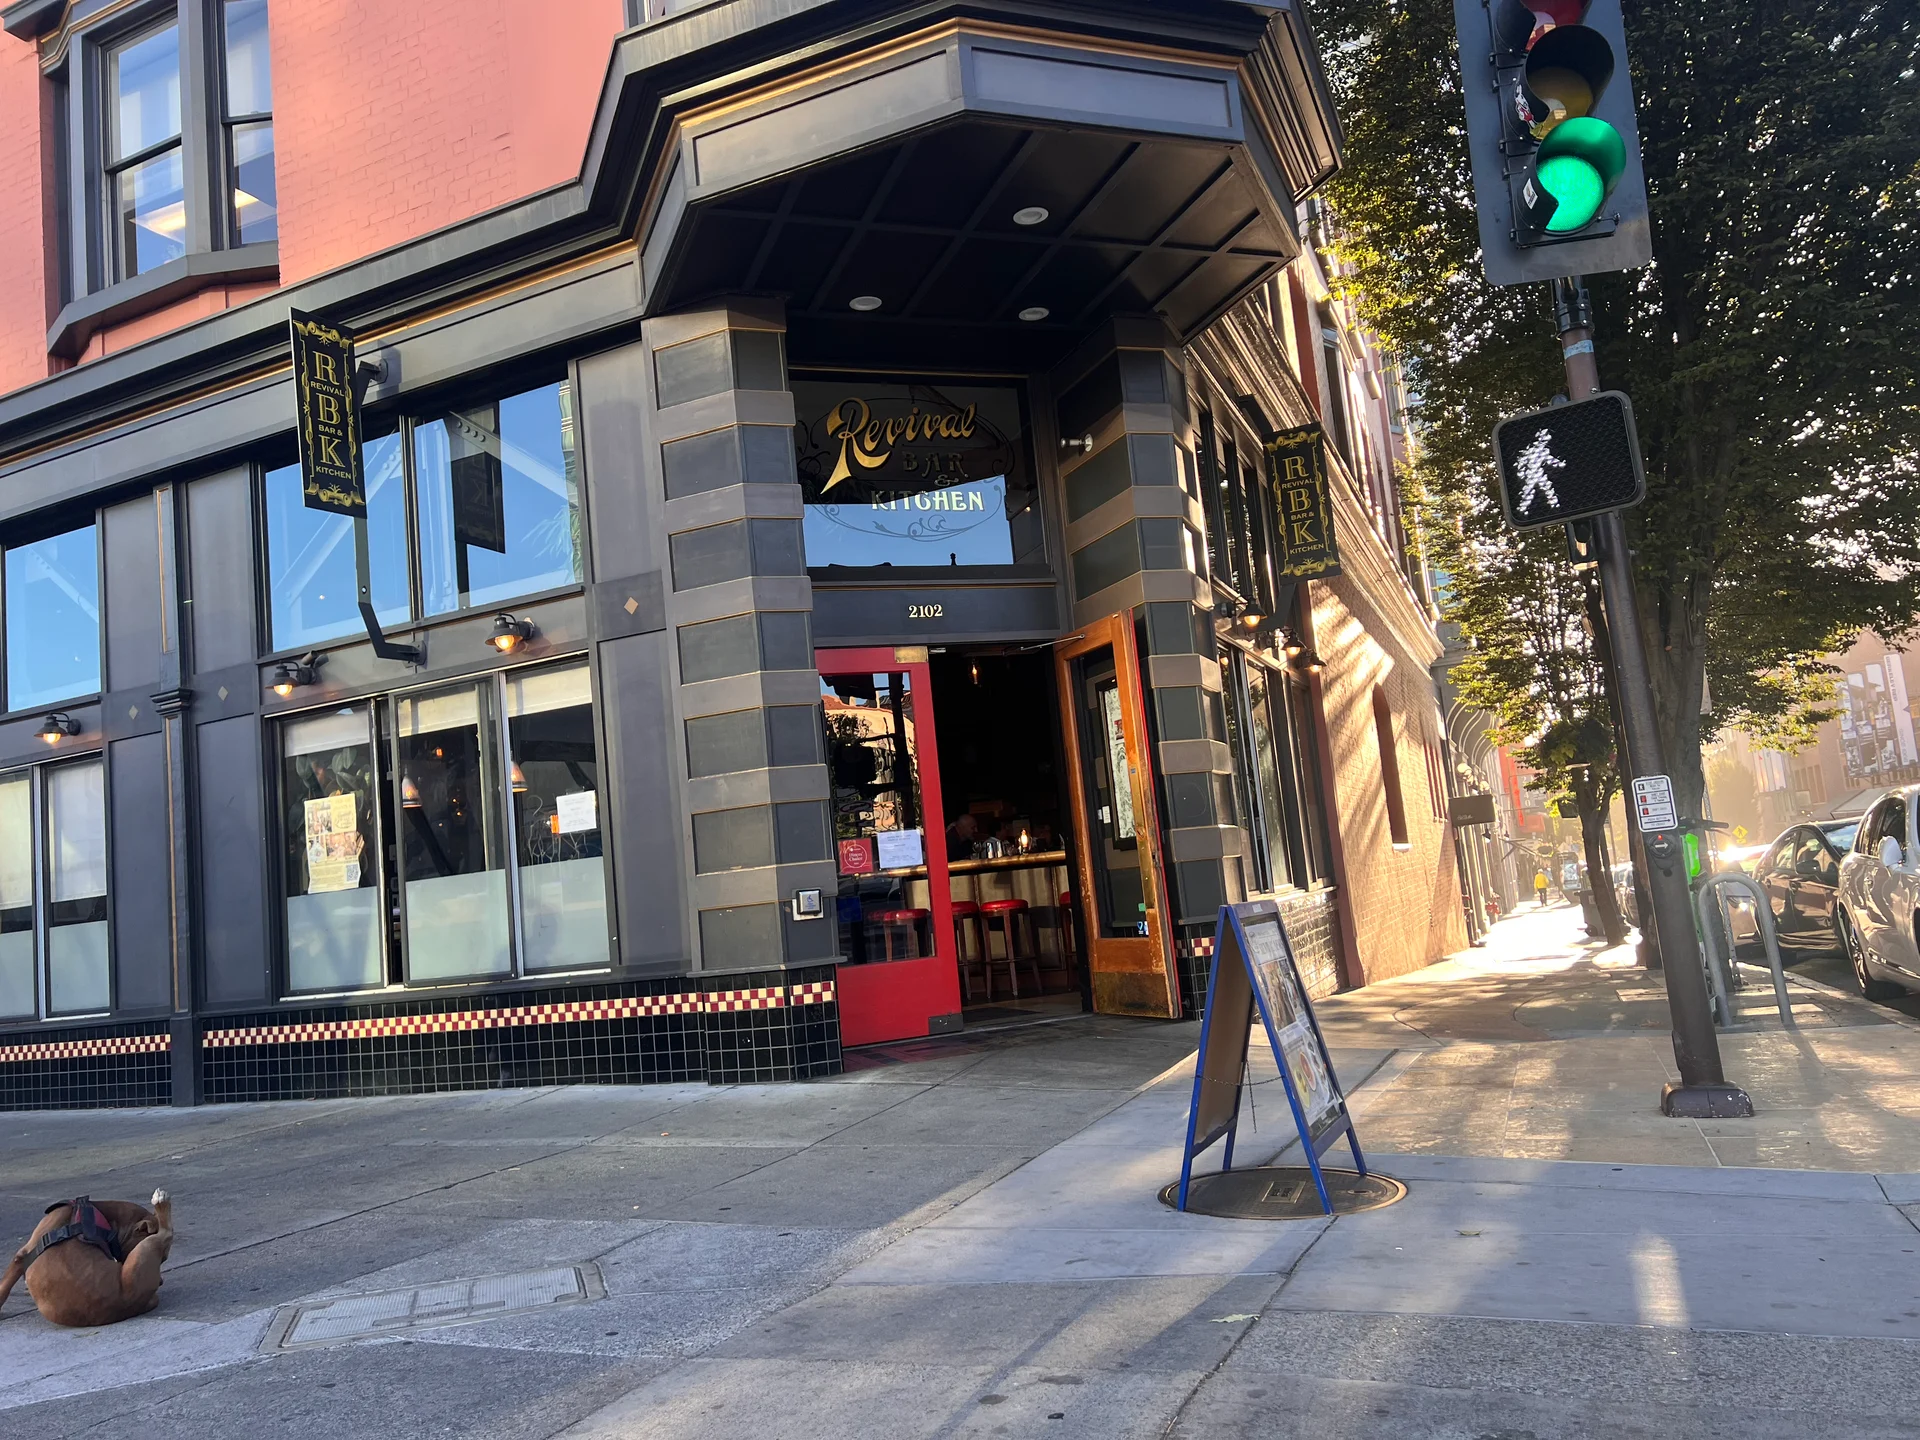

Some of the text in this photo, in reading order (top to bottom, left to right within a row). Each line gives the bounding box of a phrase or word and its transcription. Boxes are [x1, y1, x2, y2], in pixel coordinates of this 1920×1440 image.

[312, 351, 340, 386] R
[310, 381, 345, 397] REVIVAL
[316, 392, 341, 425] B
[318, 424, 336, 435] BAR
[318, 435, 346, 468] K
[820, 397, 978, 495] Revival
[315, 465, 352, 479] KITCHEN
[902, 451, 969, 478] BAR
[1282, 455, 1309, 481] R
[934, 474, 959, 487] &
[1281, 478, 1315, 489] REVIVAL
[870, 490, 985, 512] KITCHEN
[1287, 488, 1312, 513] B
[1290, 513, 1307, 521] BAR
[1291, 519, 1318, 546] K
[1289, 543, 1325, 555] KITCHEN
[908, 604, 943, 618] 2102
